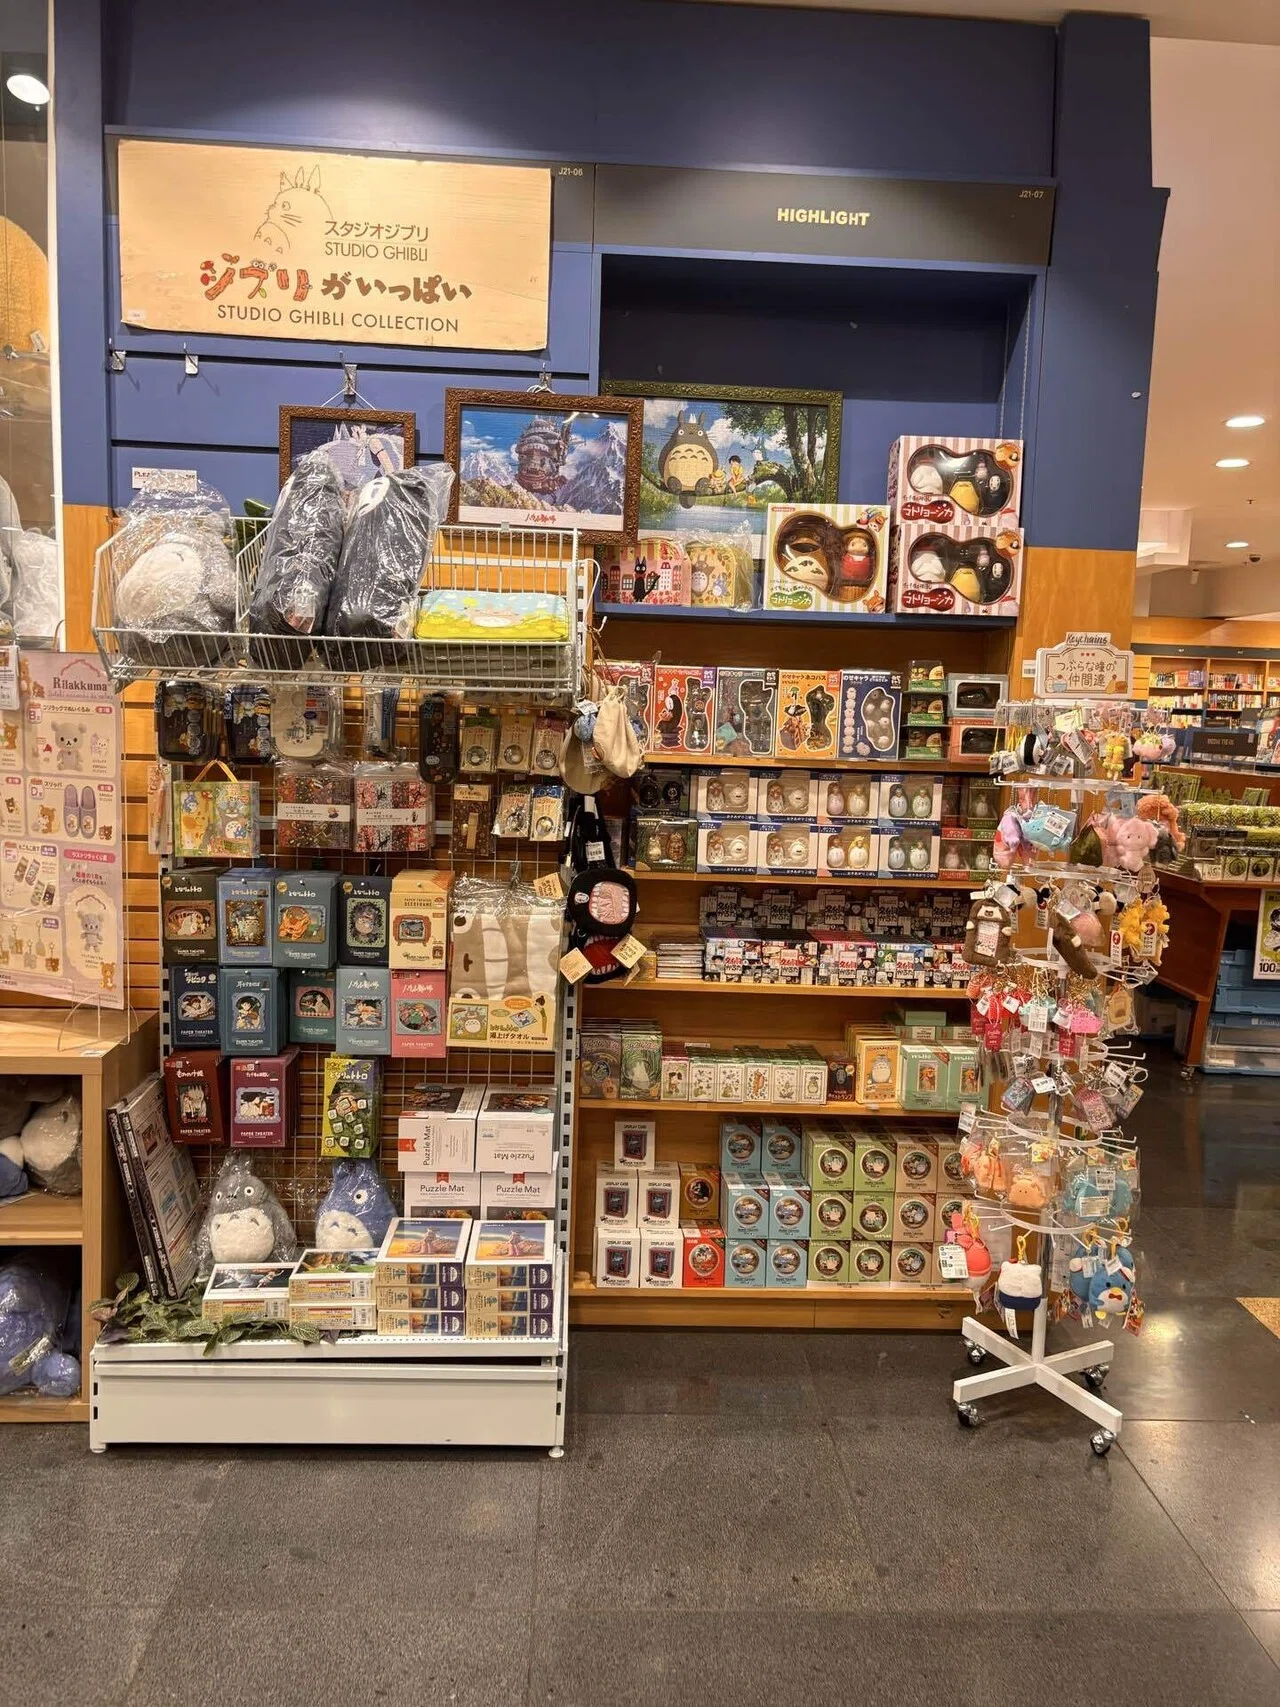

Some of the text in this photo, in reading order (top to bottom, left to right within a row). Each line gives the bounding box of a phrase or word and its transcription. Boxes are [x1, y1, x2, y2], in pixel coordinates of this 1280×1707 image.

[558, 167, 584, 177] J21-06
[1019, 190, 1045, 200] J21-07
[777, 207, 869, 227] HIGHLIGHT
[325, 219, 429, 243] スタジオジブリ
[324, 240, 428, 262] STUDIO GHIBLI
[200, 253, 472, 304] ジブリがいっぱい
[217, 304, 459, 333] STUDIO GHIBLI COLLECTION
[1066, 633, 1108, 647] Keychains
[53, 676, 107, 691] Rilakkuma
[1260, 962, 1276, 973] 100
[423, 1125, 432, 1166] Puzzle Mat
[494, 1152, 535, 1161] Puzzle Mat
[420, 1185, 447, 1193] Puzzle
[496, 1185, 541, 1194] Puzzle Mat
